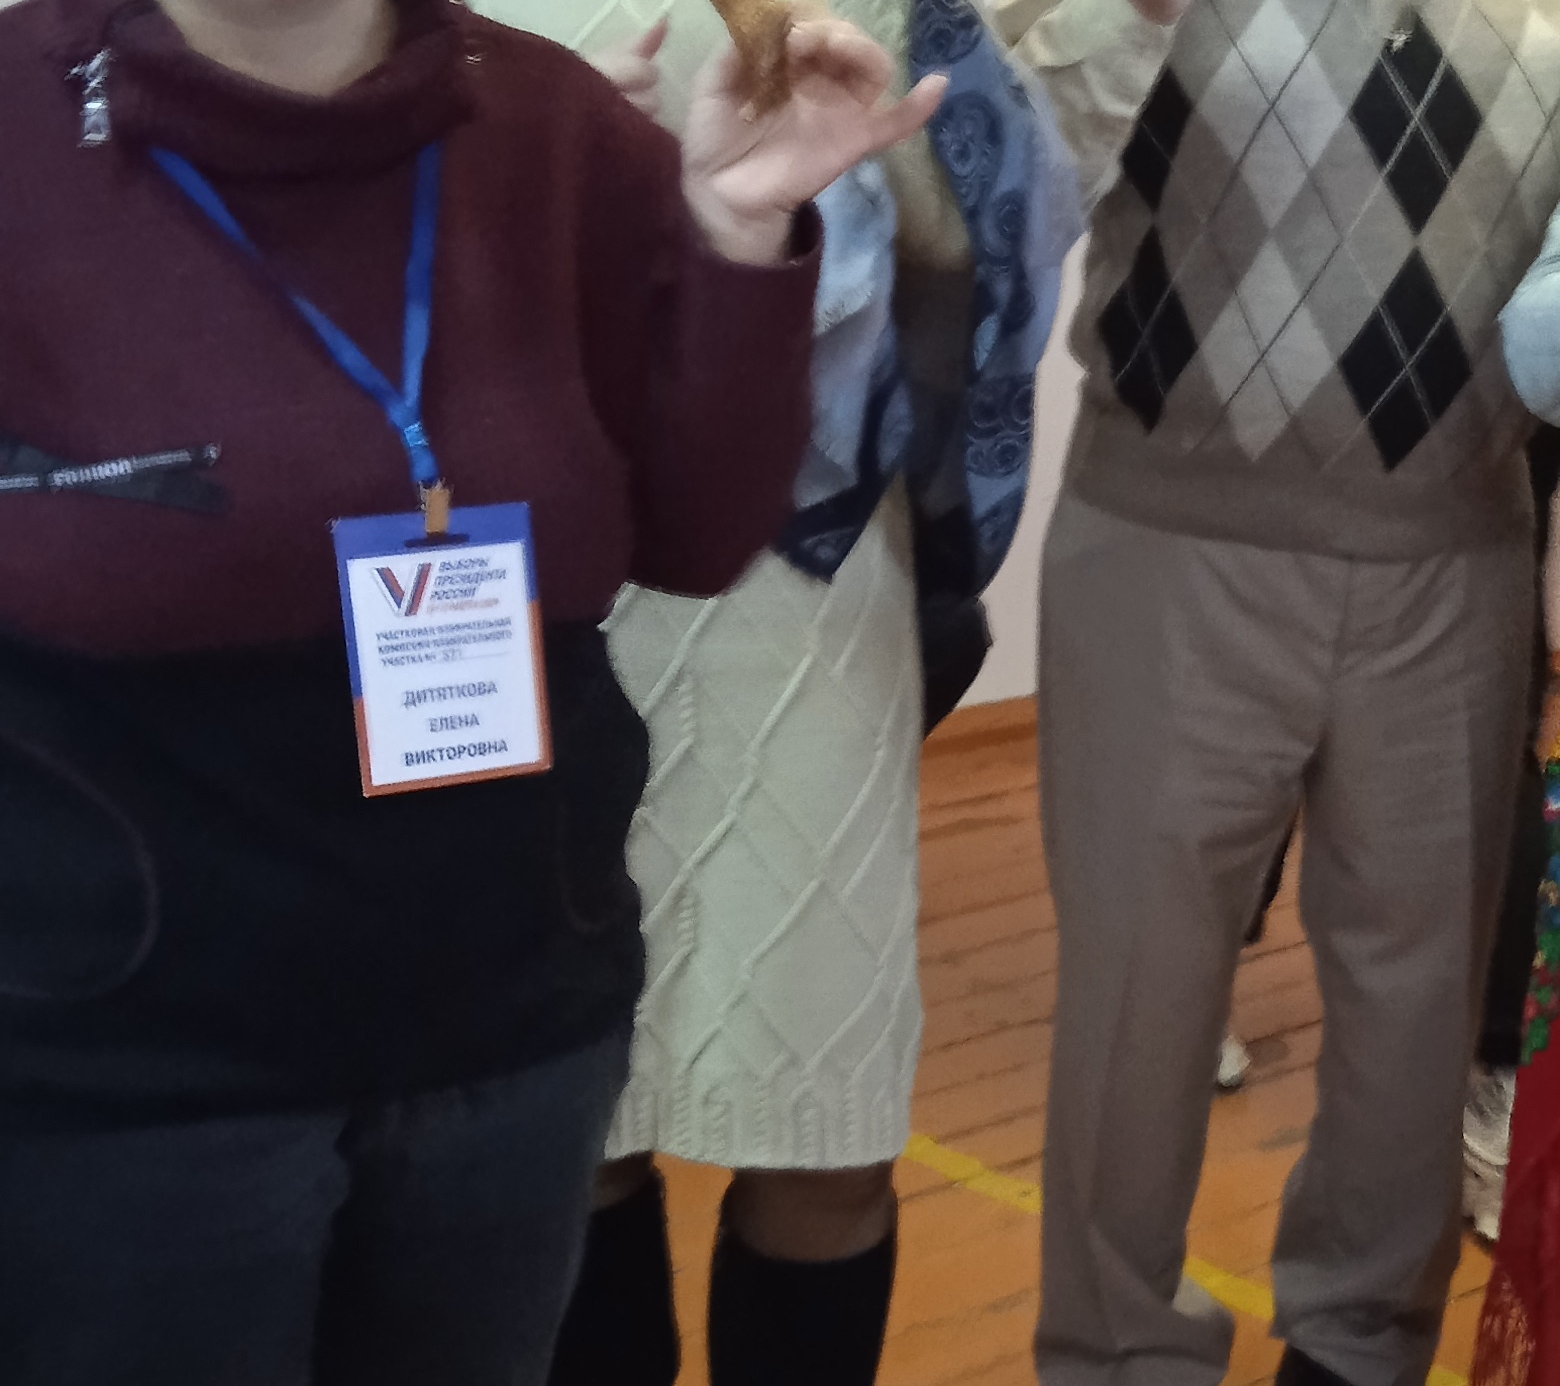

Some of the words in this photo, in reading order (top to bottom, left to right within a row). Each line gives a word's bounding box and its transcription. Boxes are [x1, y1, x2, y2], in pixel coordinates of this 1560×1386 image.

[438, 557, 490, 573] ВЫБОРЫ
[434, 569, 507, 587] ПРЕЗИДЕНТА
[430, 587, 477, 601] РОССИИ
[376, 626, 436, 642] УЧАСТКОВАЯ
[381, 652, 424, 668] УЧАСТКА
[403, 681, 499, 709] ДИТЯТКОВА
[428, 713, 480, 733] ЕЛЕНА
[404, 739, 509, 767] ВИКТОРОВНА
